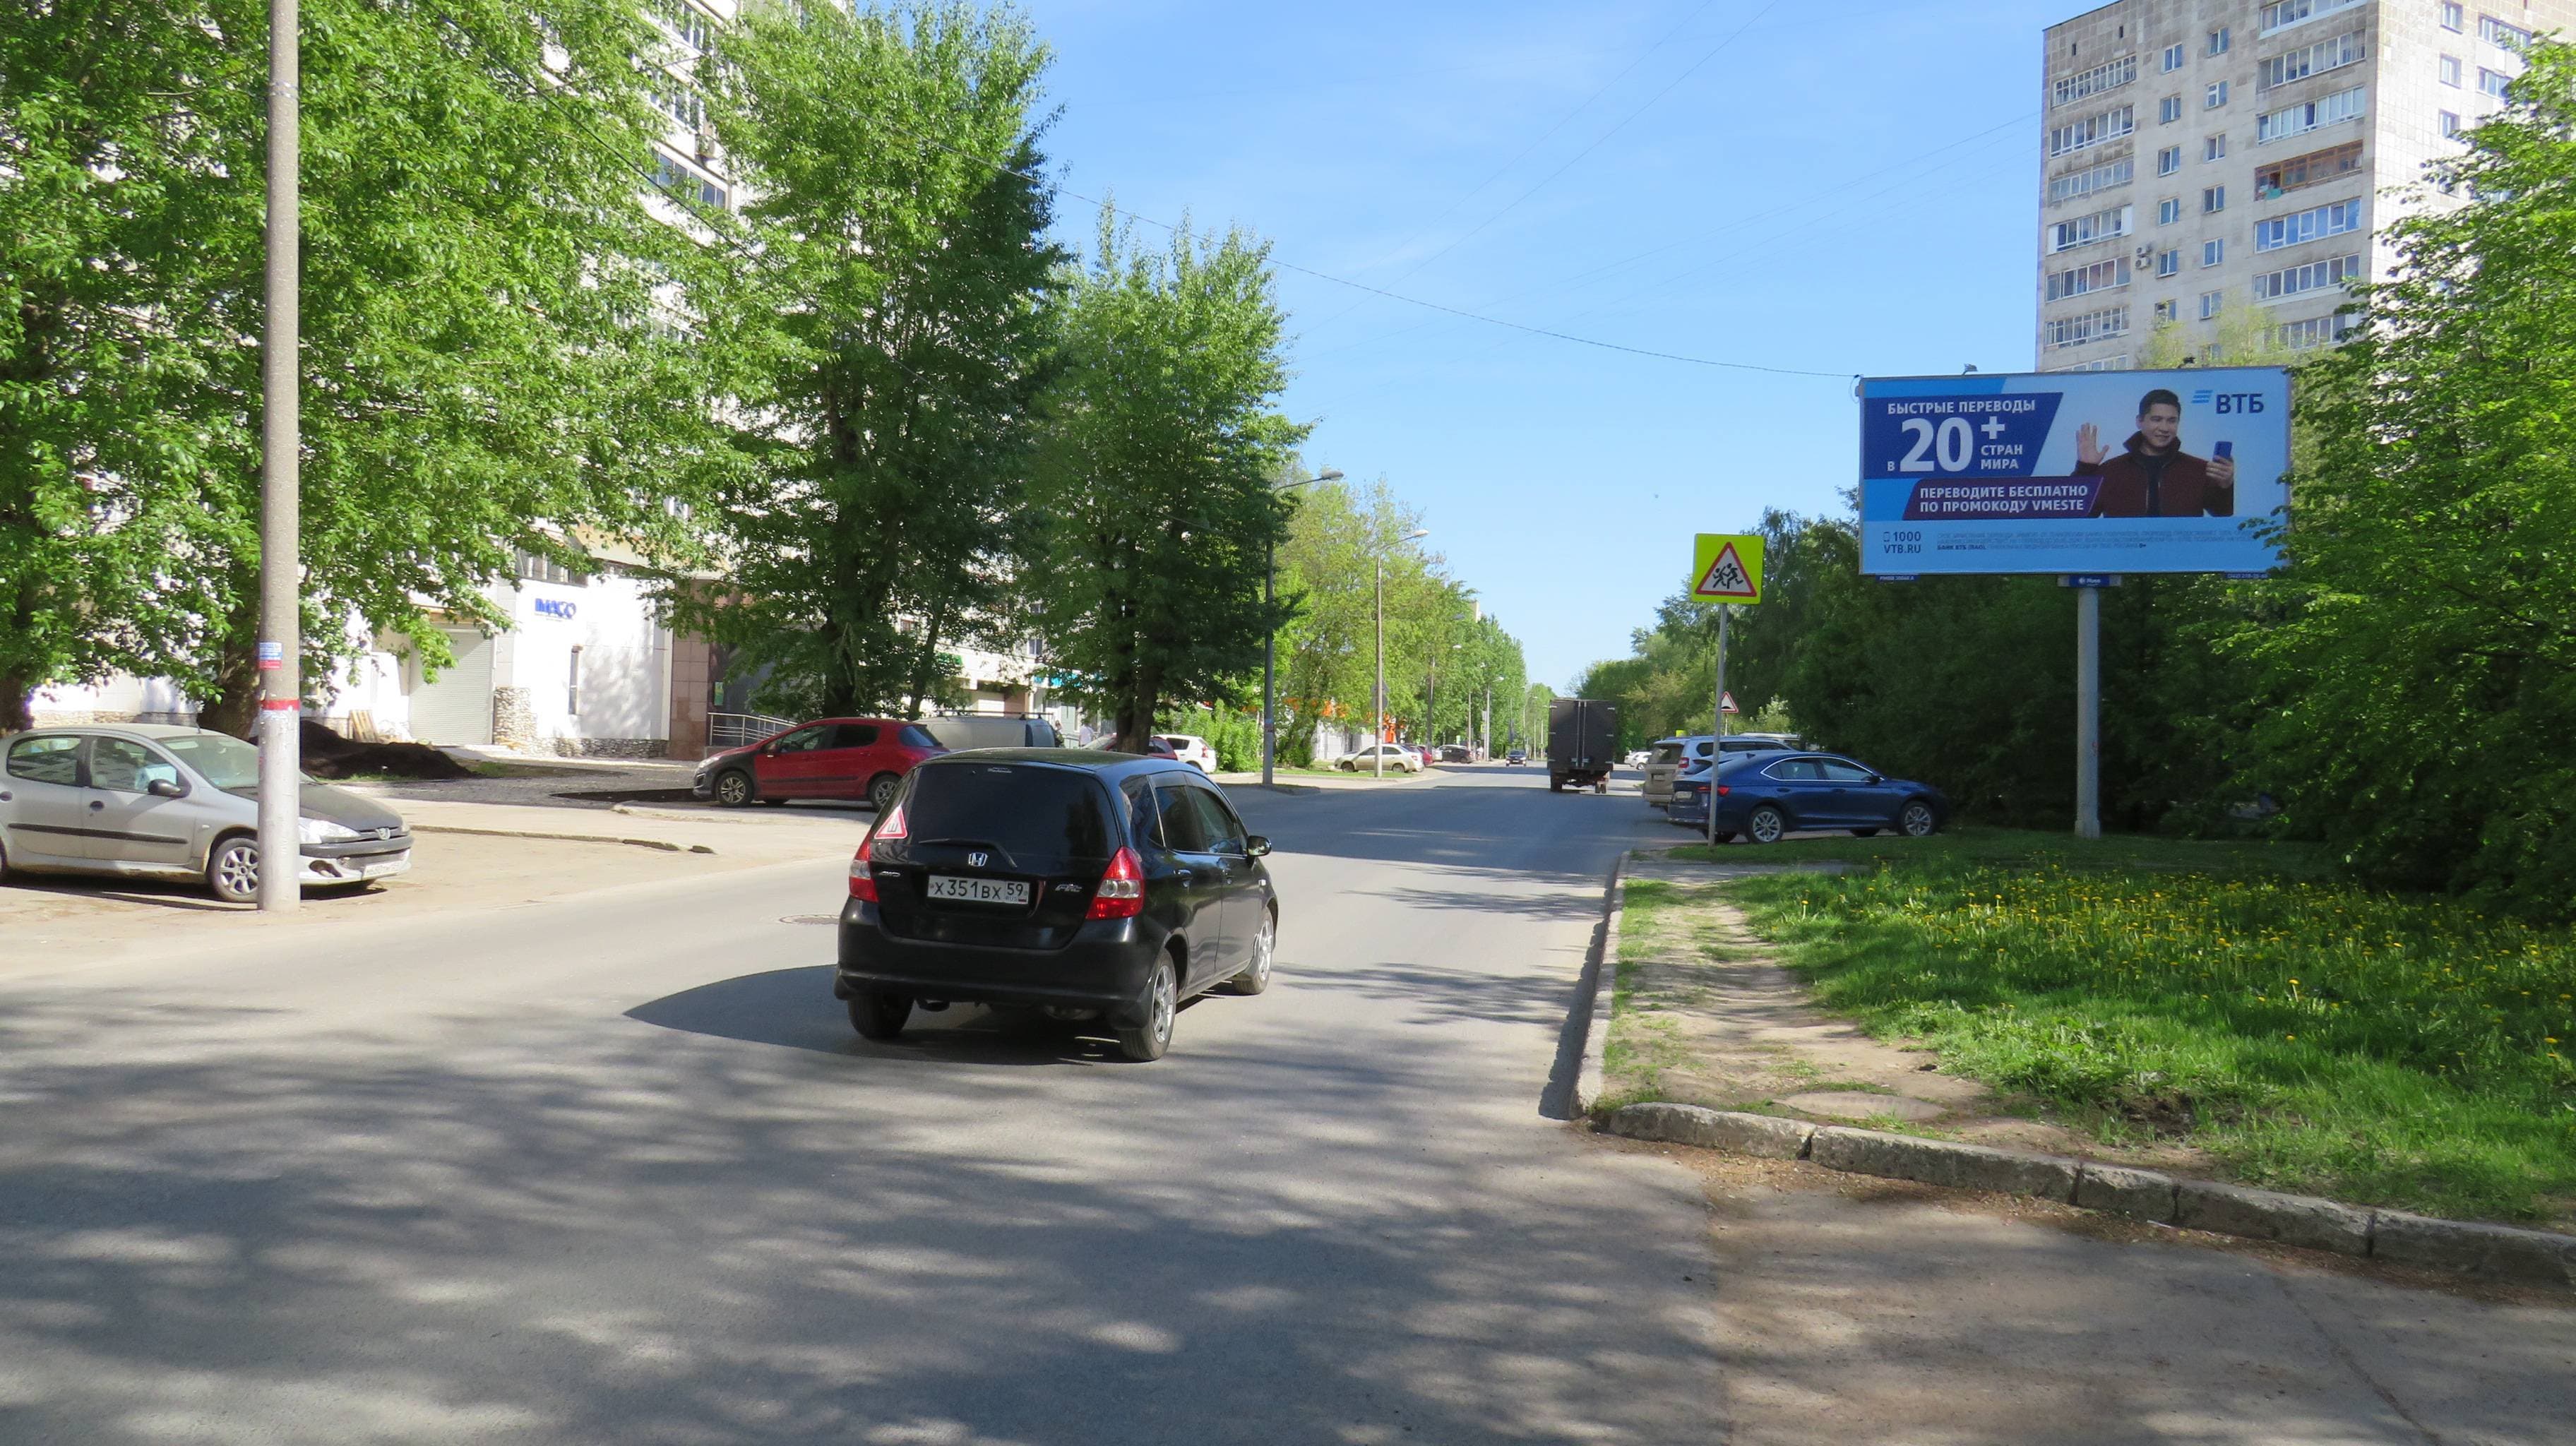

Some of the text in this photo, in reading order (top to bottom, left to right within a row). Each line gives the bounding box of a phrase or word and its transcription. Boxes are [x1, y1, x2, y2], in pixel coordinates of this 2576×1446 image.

[1888, 399, 2036, 415] БЫСТРЫЕ ПЕРЕВОДЫ
[2216, 393, 2265, 414] ВТБ
[1981, 444, 2023, 455] СТРАН
[1981, 459, 2019, 470] МИРА
[1920, 485, 2088, 499] ПЕРЕВОДИТЕ БЕСПЛАТНО
[1920, 499, 2084, 513] ПО ПРОМОКОДУ VMESTE
[1893, 531, 1921, 542] 1000
[1884, 544, 1921, 554] VTB.RU
[1007, 883, 1023, 896] 59
